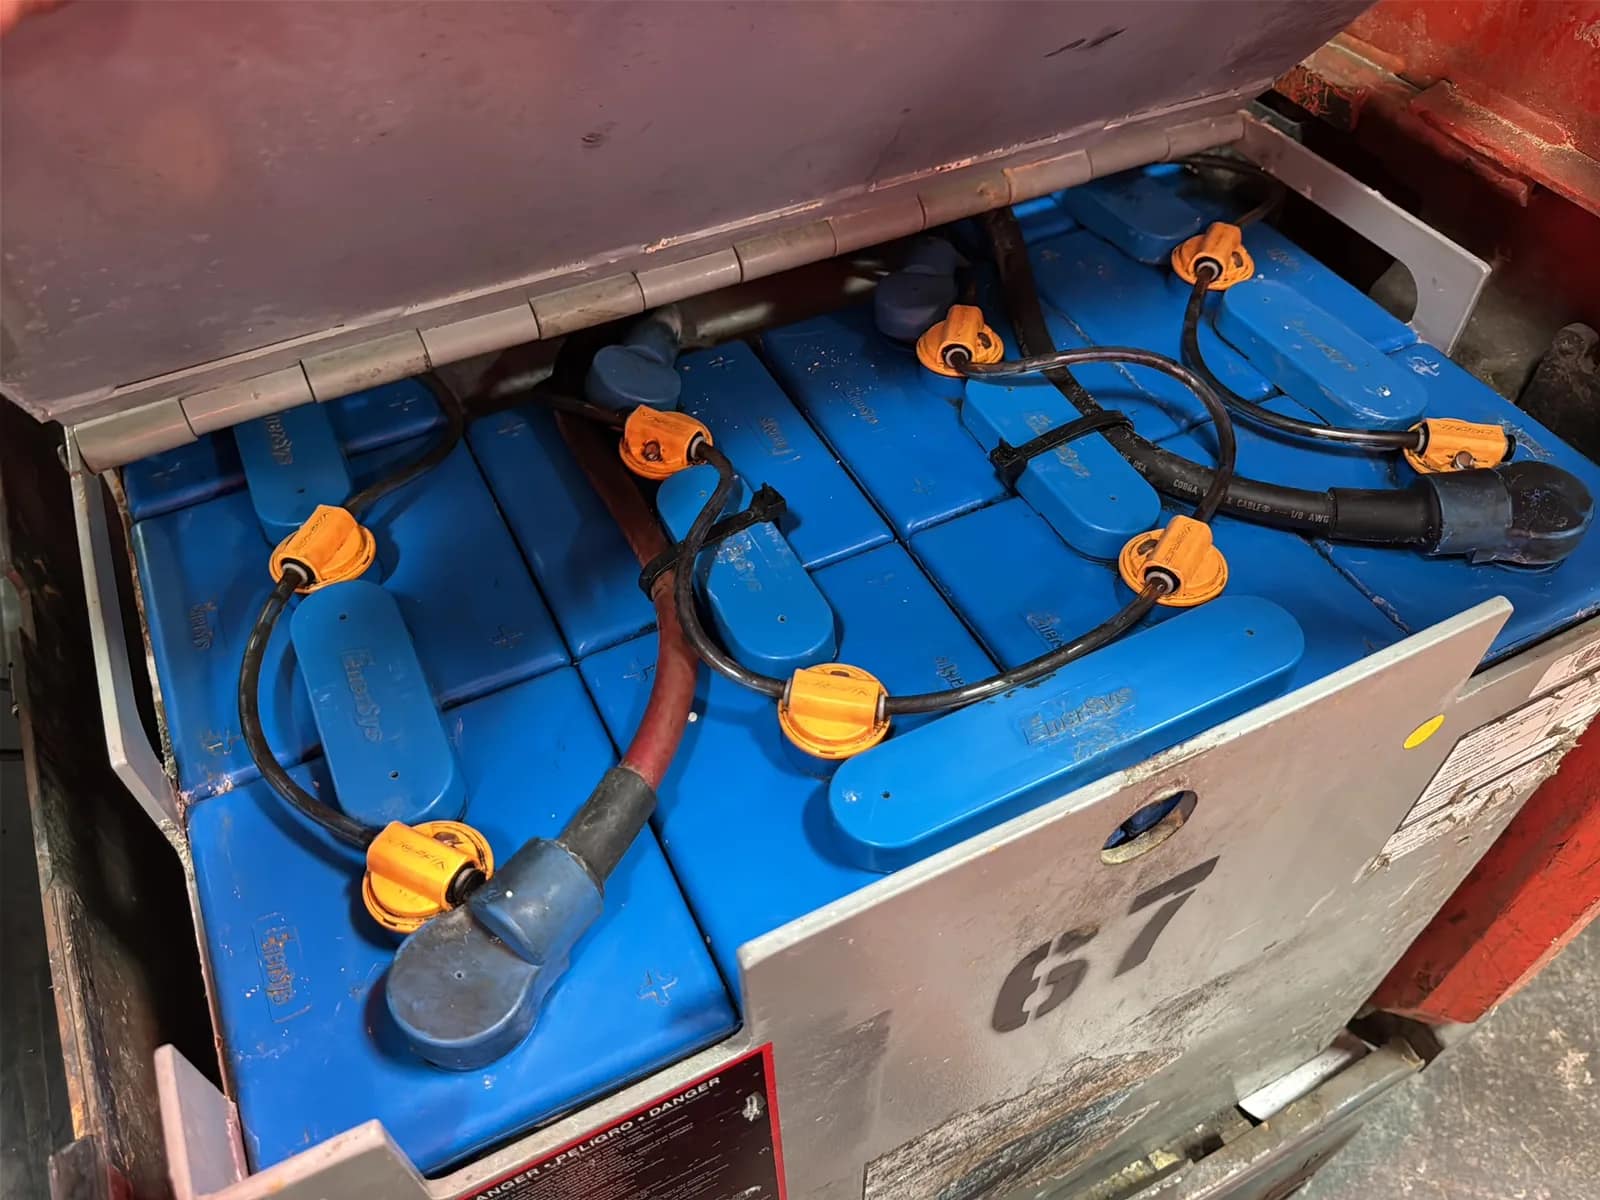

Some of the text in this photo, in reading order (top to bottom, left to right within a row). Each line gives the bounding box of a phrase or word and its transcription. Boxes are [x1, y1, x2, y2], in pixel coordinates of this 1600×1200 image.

[1173, 479, 1198, 495] COBRA
[1308, 513, 1330, 524] AWG
[991, 855, 1220, 1033] 67
[475, 1077, 721, 1200] ANGER PELIGRO DANGER
